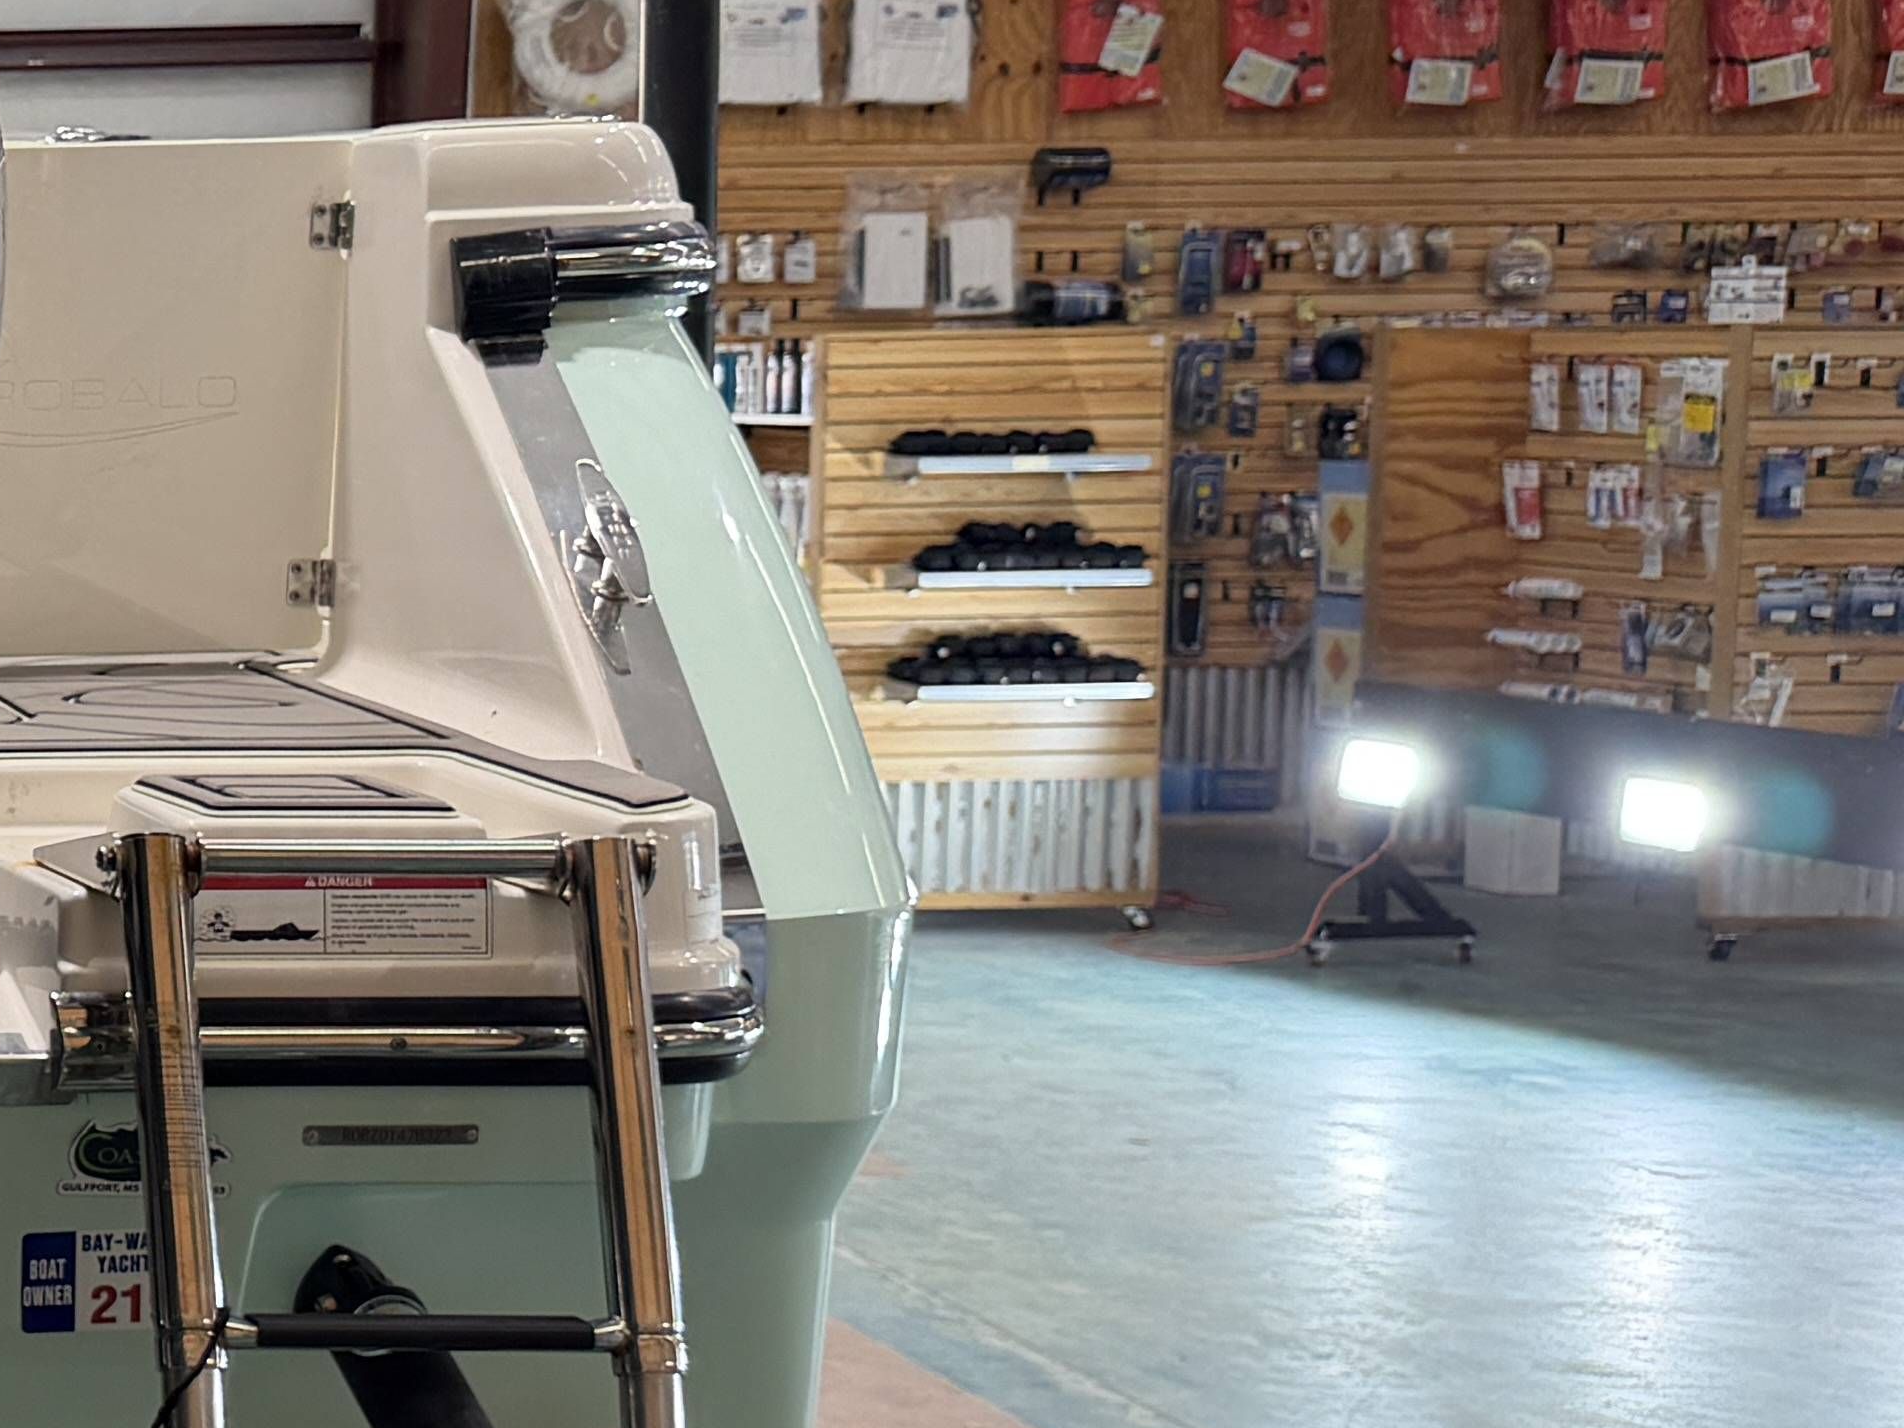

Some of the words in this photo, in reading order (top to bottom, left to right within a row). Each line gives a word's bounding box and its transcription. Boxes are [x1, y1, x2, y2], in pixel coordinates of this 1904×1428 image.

[318, 876, 373, 888] DANGER
[61, 1183, 120, 1194] GULFPORT,
[123, 1184, 140, 1193] MS
[29, 1258, 67, 1280] BOAT
[23, 1285, 73, 1308] OWNER
[90, 1283, 142, 1325] 21
